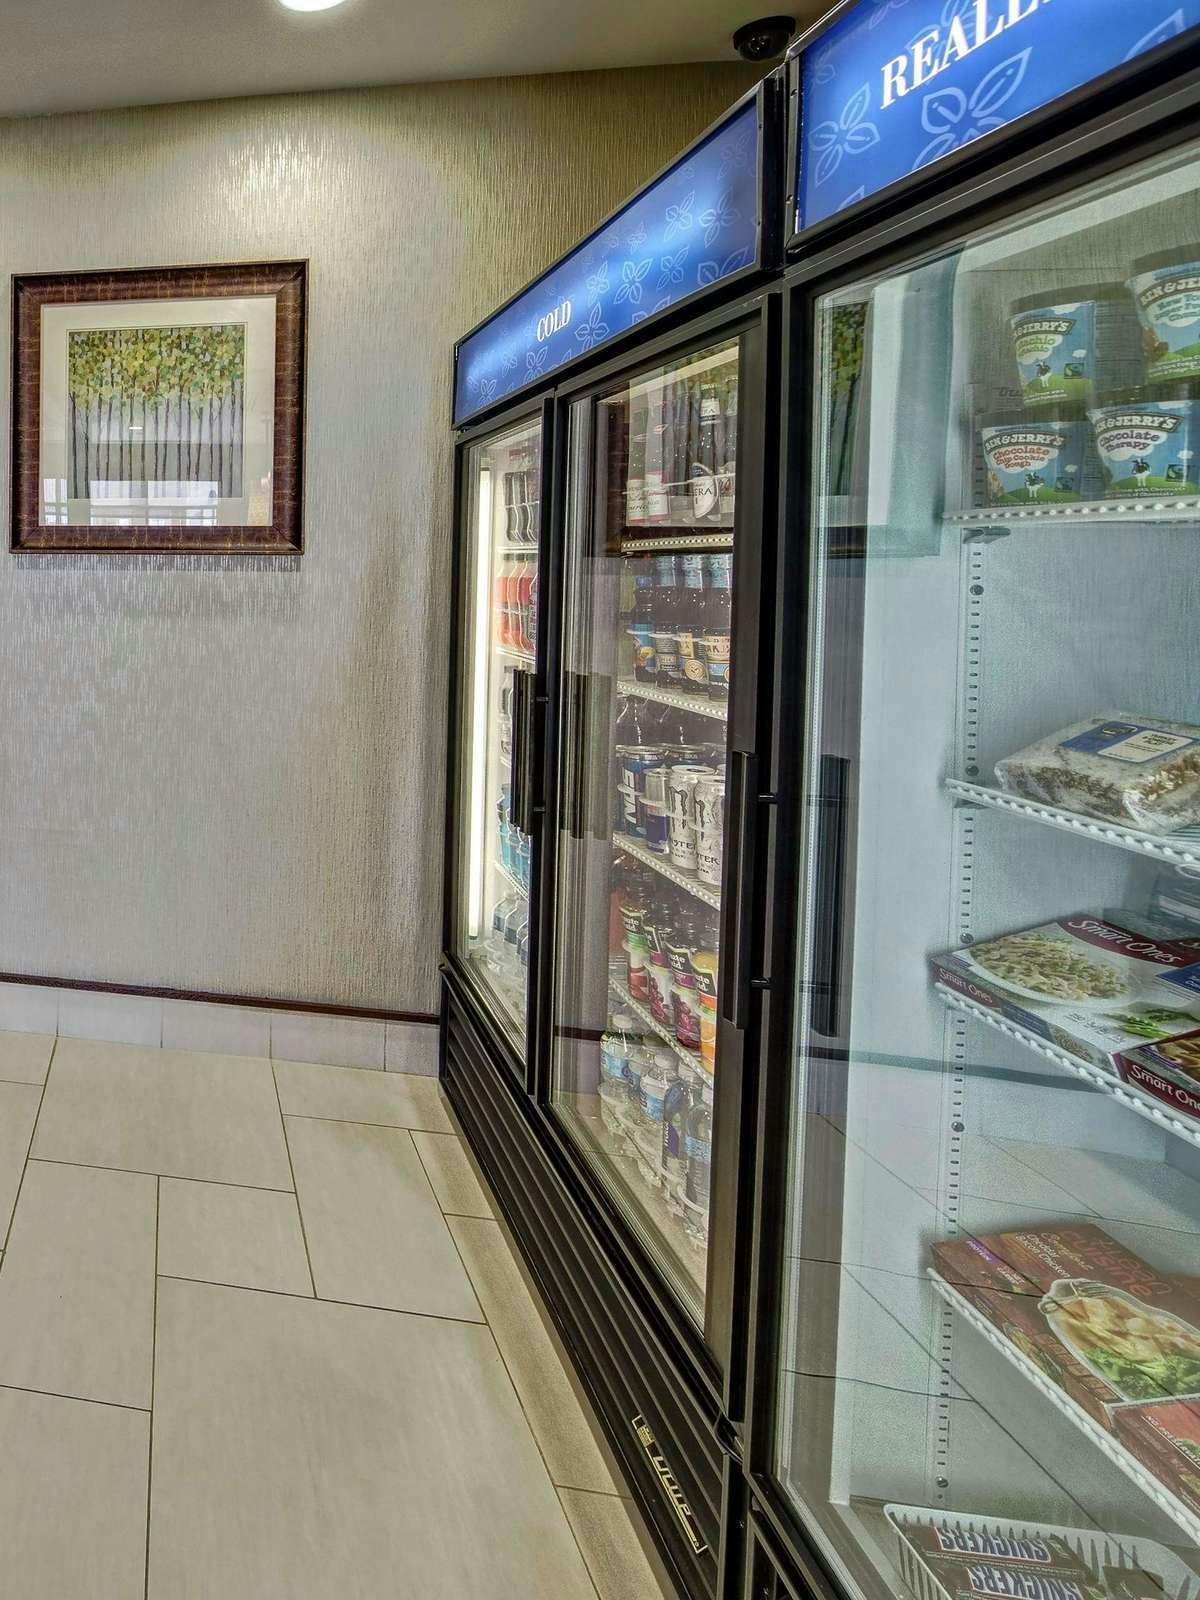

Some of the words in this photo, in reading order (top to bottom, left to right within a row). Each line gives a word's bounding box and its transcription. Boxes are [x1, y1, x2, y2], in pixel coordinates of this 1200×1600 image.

[537, 301, 570, 342] COLD
[993, 446, 1050, 461] Chocolate
[1068, 920, 1134, 944] Smart
[1125, 942, 1185, 963] Ones
[939, 967, 968, 991] Smart
[967, 983, 994, 1004] Ones
[1130, 1063, 1175, 1096] Smart
[1038, 1252, 1071, 1279] Chicken
[939, 1528, 1051, 1563] SNICKERS
